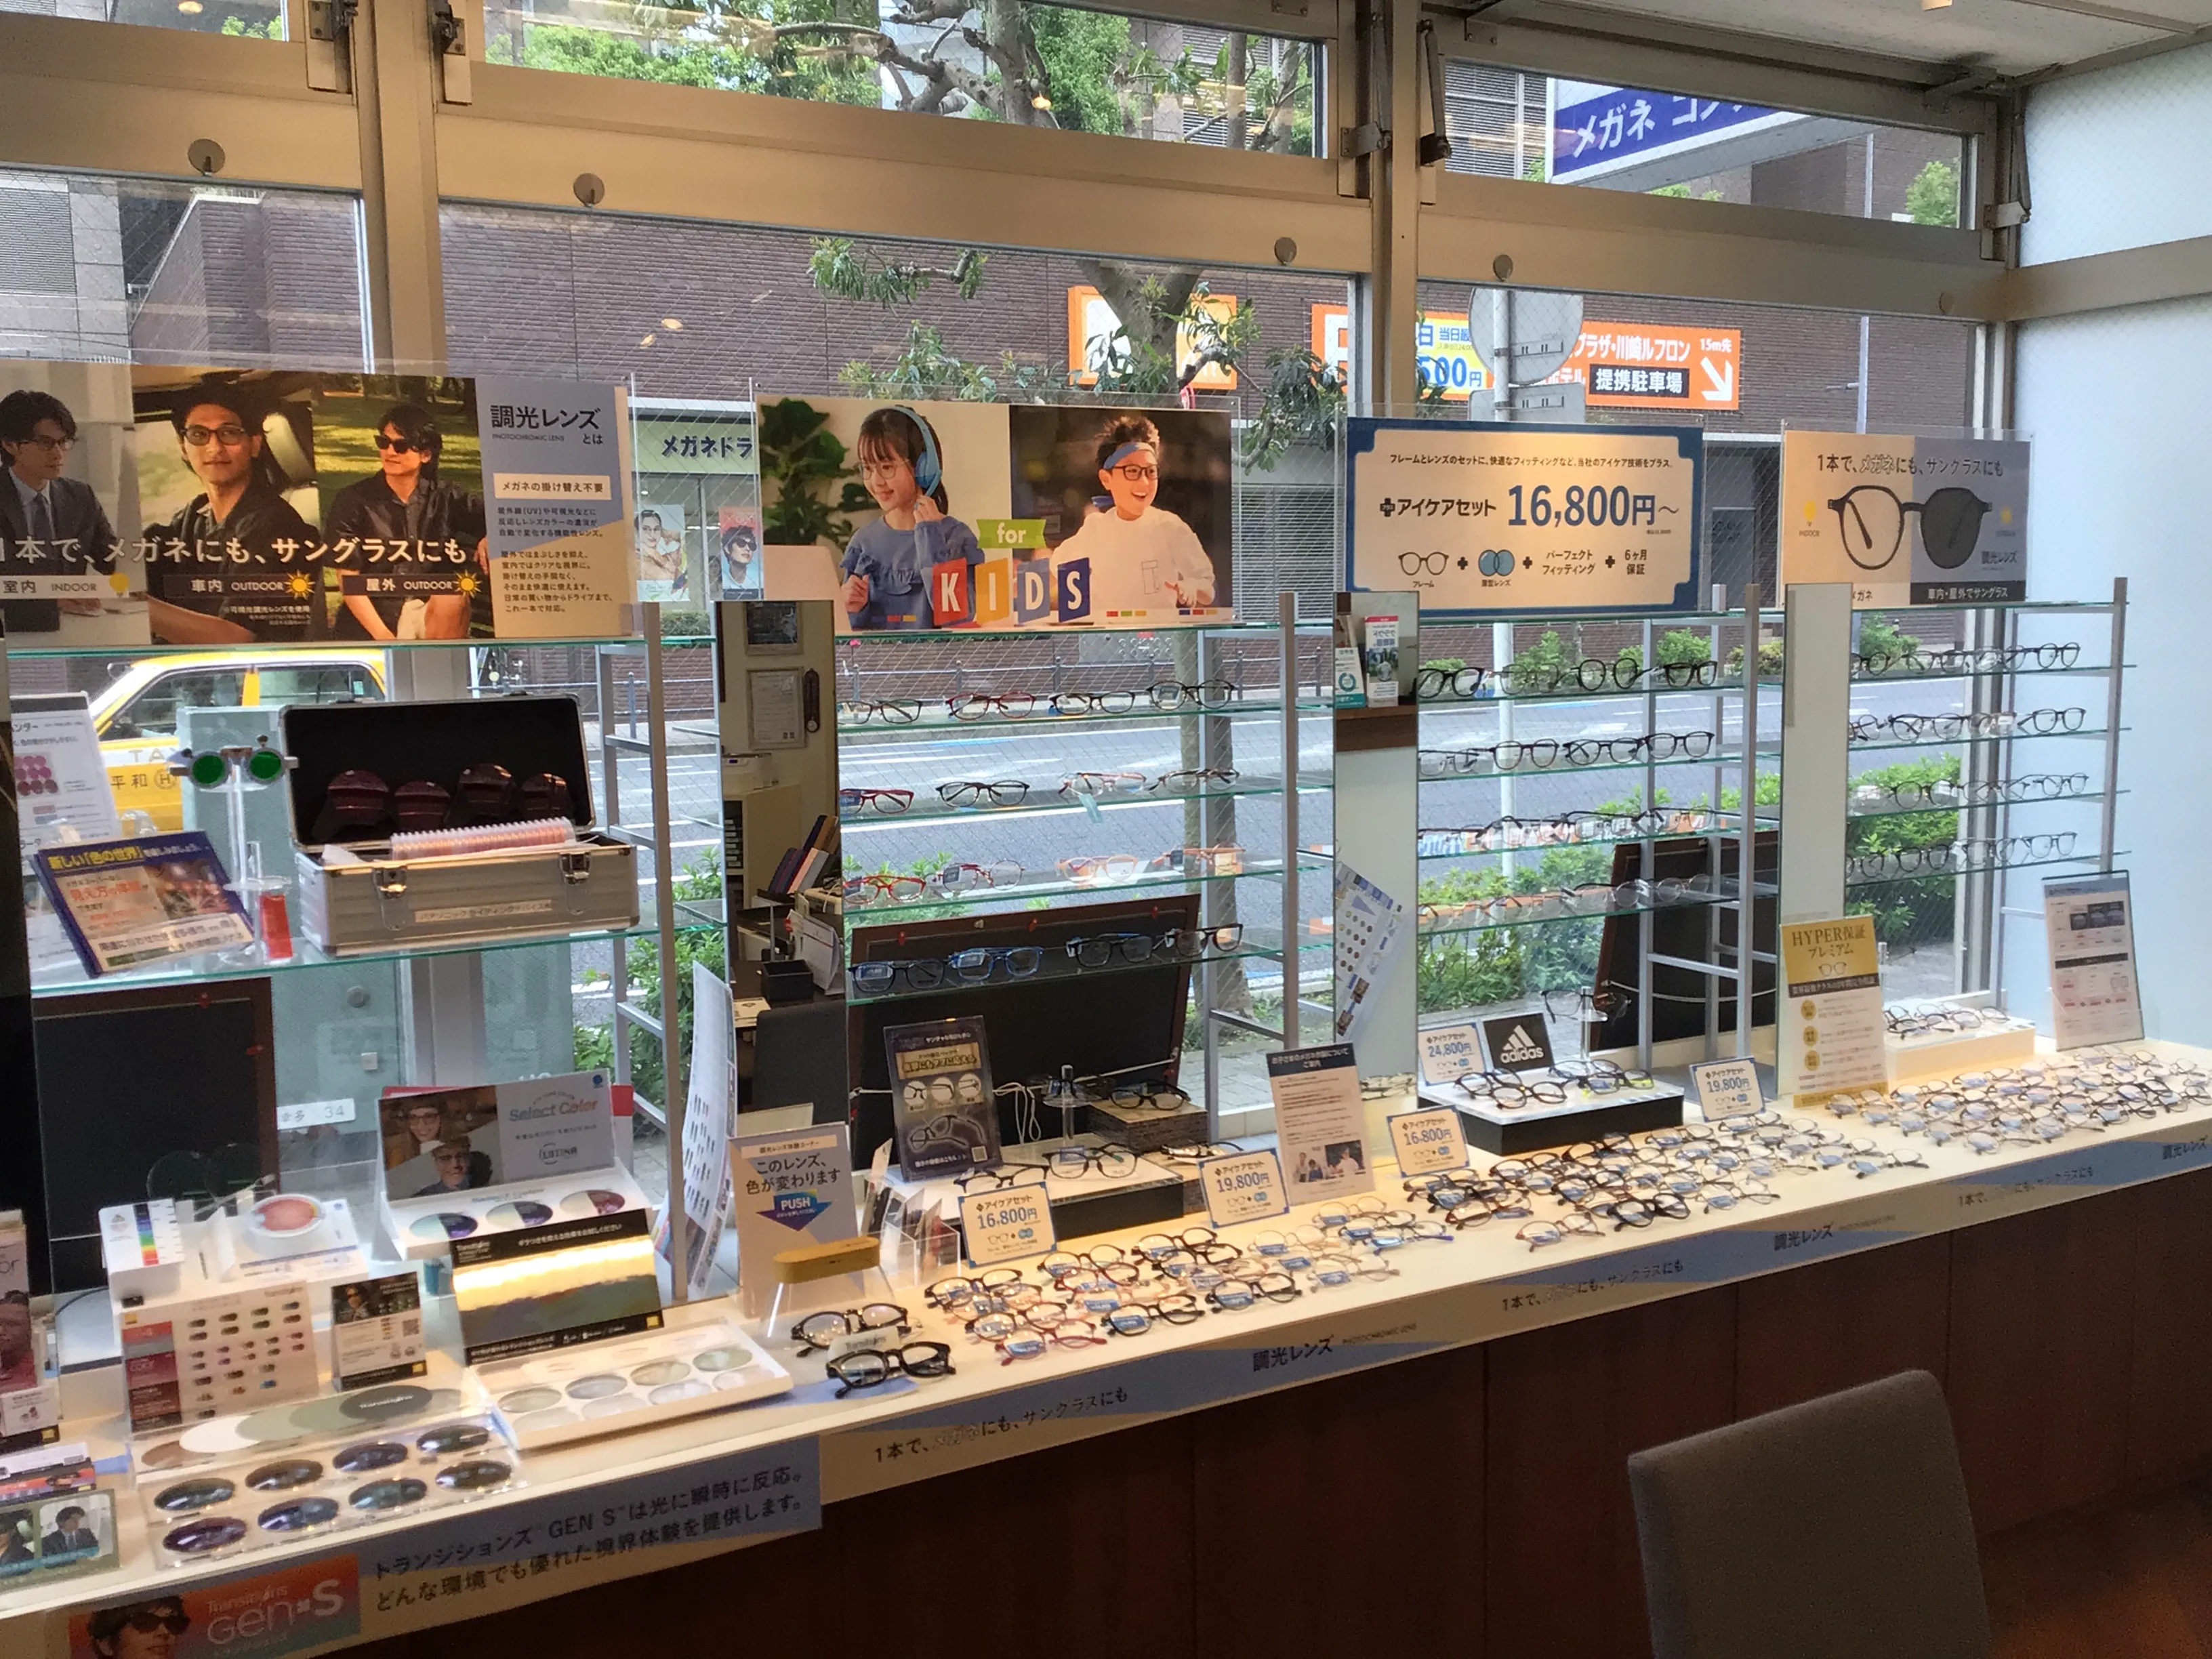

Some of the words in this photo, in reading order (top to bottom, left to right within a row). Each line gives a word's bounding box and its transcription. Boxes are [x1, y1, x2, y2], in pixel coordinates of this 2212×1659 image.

[1573, 99, 1656, 158] メガネ
[1672, 96, 1742, 126] コン
[1700, 337, 1732, 353] 15m先
[1595, 368, 1683, 394] 提携駐車場
[490, 405, 601, 430] 調光レンズ
[582, 434, 604, 445] とは
[661, 435, 753, 459] メガネドラ
[502, 482, 603, 493] メガネの掛け替え不要
[1397, 499, 1497, 517] アイケアセット
[997, 522, 1027, 544] for
[1546, 550, 1593, 560] パーフェクト
[1542, 564, 1596, 575] フィッティング
[1626, 564, 1645, 575] 保証
[3, 580, 37, 594] 室内
[51, 583, 97, 592] INDOOR
[191, 579, 222, 594] 車内
[231, 581, 284, 592] OUTDOOR
[366, 578, 396, 592] 屋外
[403, 581, 453, 590] OUTDOOR
[941, 571, 1082, 612] KIDS
[1412, 580, 1435, 588] フレーム
[1808, 943, 1855, 959] プレミアム
[1428, 1042, 1472, 1058] 24,800円
[1500, 1047, 1544, 1064] adidas
[1706, 1077, 1750, 1093] 19,800円
[509, 1103, 556, 1122] Select
[559, 1099, 598, 1115] Color
[1404, 1128, 1453, 1145] 16,800円
[756, 1152, 827, 1174] このレンズ、
[745, 1168, 841, 1195] 色が変わります
[1216, 1172, 1270, 1193] 19,800円
[781, 1197, 811, 1211] PUSH
[984, 1195, 1033, 1210] アイケアセット
[977, 1206, 1038, 1230] 16,800円
[1774, 1224, 1835, 1252] 調光レンズ
[1253, 1334, 1334, 1372] 調光レンズ
[548, 1511, 594, 1540] GEN
